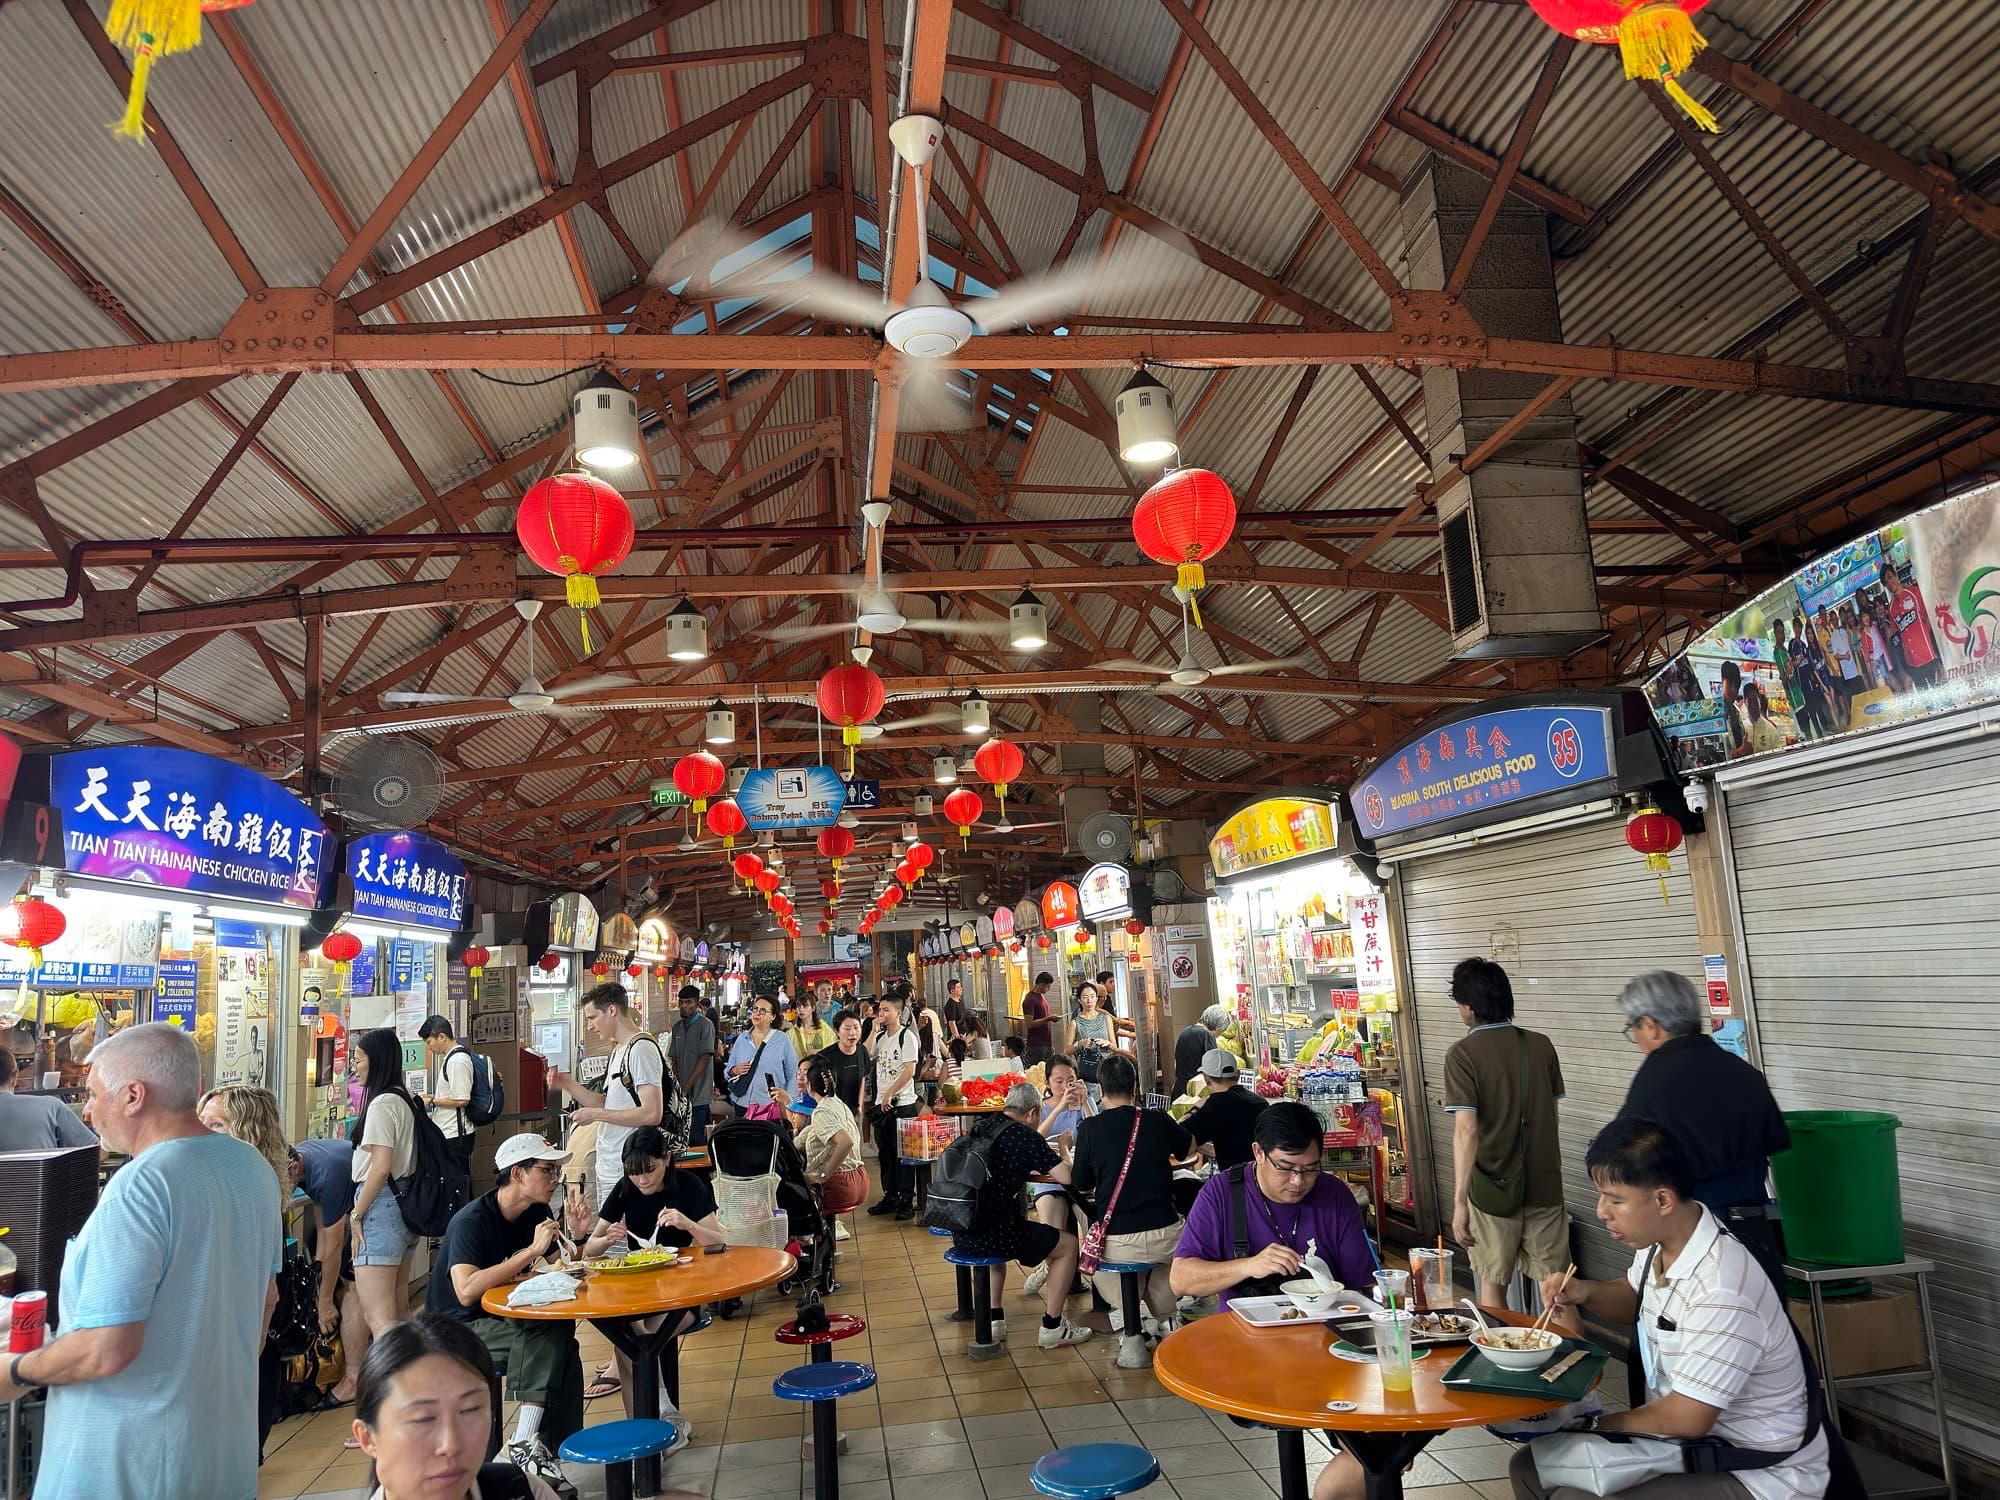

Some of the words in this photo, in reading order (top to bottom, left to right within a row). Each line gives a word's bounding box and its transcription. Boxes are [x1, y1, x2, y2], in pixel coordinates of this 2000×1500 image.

[1552, 728, 1577, 769] 35
[1423, 779, 1452, 800] SOUTH
[1454, 765, 1502, 791] DELICIOUS
[1505, 753, 1536, 776] FOOD
[74, 766, 293, 864] 天天海南雞飯
[659, 791, 681, 804] EXIT
[766, 803, 786, 812] Tray
[1366, 794, 1382, 822] 35
[35, 807, 50, 863] 9
[1239, 841, 1292, 865] MAXWELL
[70, 831, 109, 857] TIAN
[112, 838, 147, 864] TIAN
[149, 847, 221, 878] HAINANESE
[224, 863, 268, 886] CHICKEN
[270, 873, 290, 890] RICE
[355, 847, 451, 900] 天天海南雞飯
[370, 892, 385, 907] TIAN
[385, 895, 417, 913] HAINANESE
[416, 901, 438, 916] CHICKEN
[438, 906, 448, 918] RICE
[1361, 911, 1384, 973] 甘蔗汁
[158, 977, 166, 996] B
